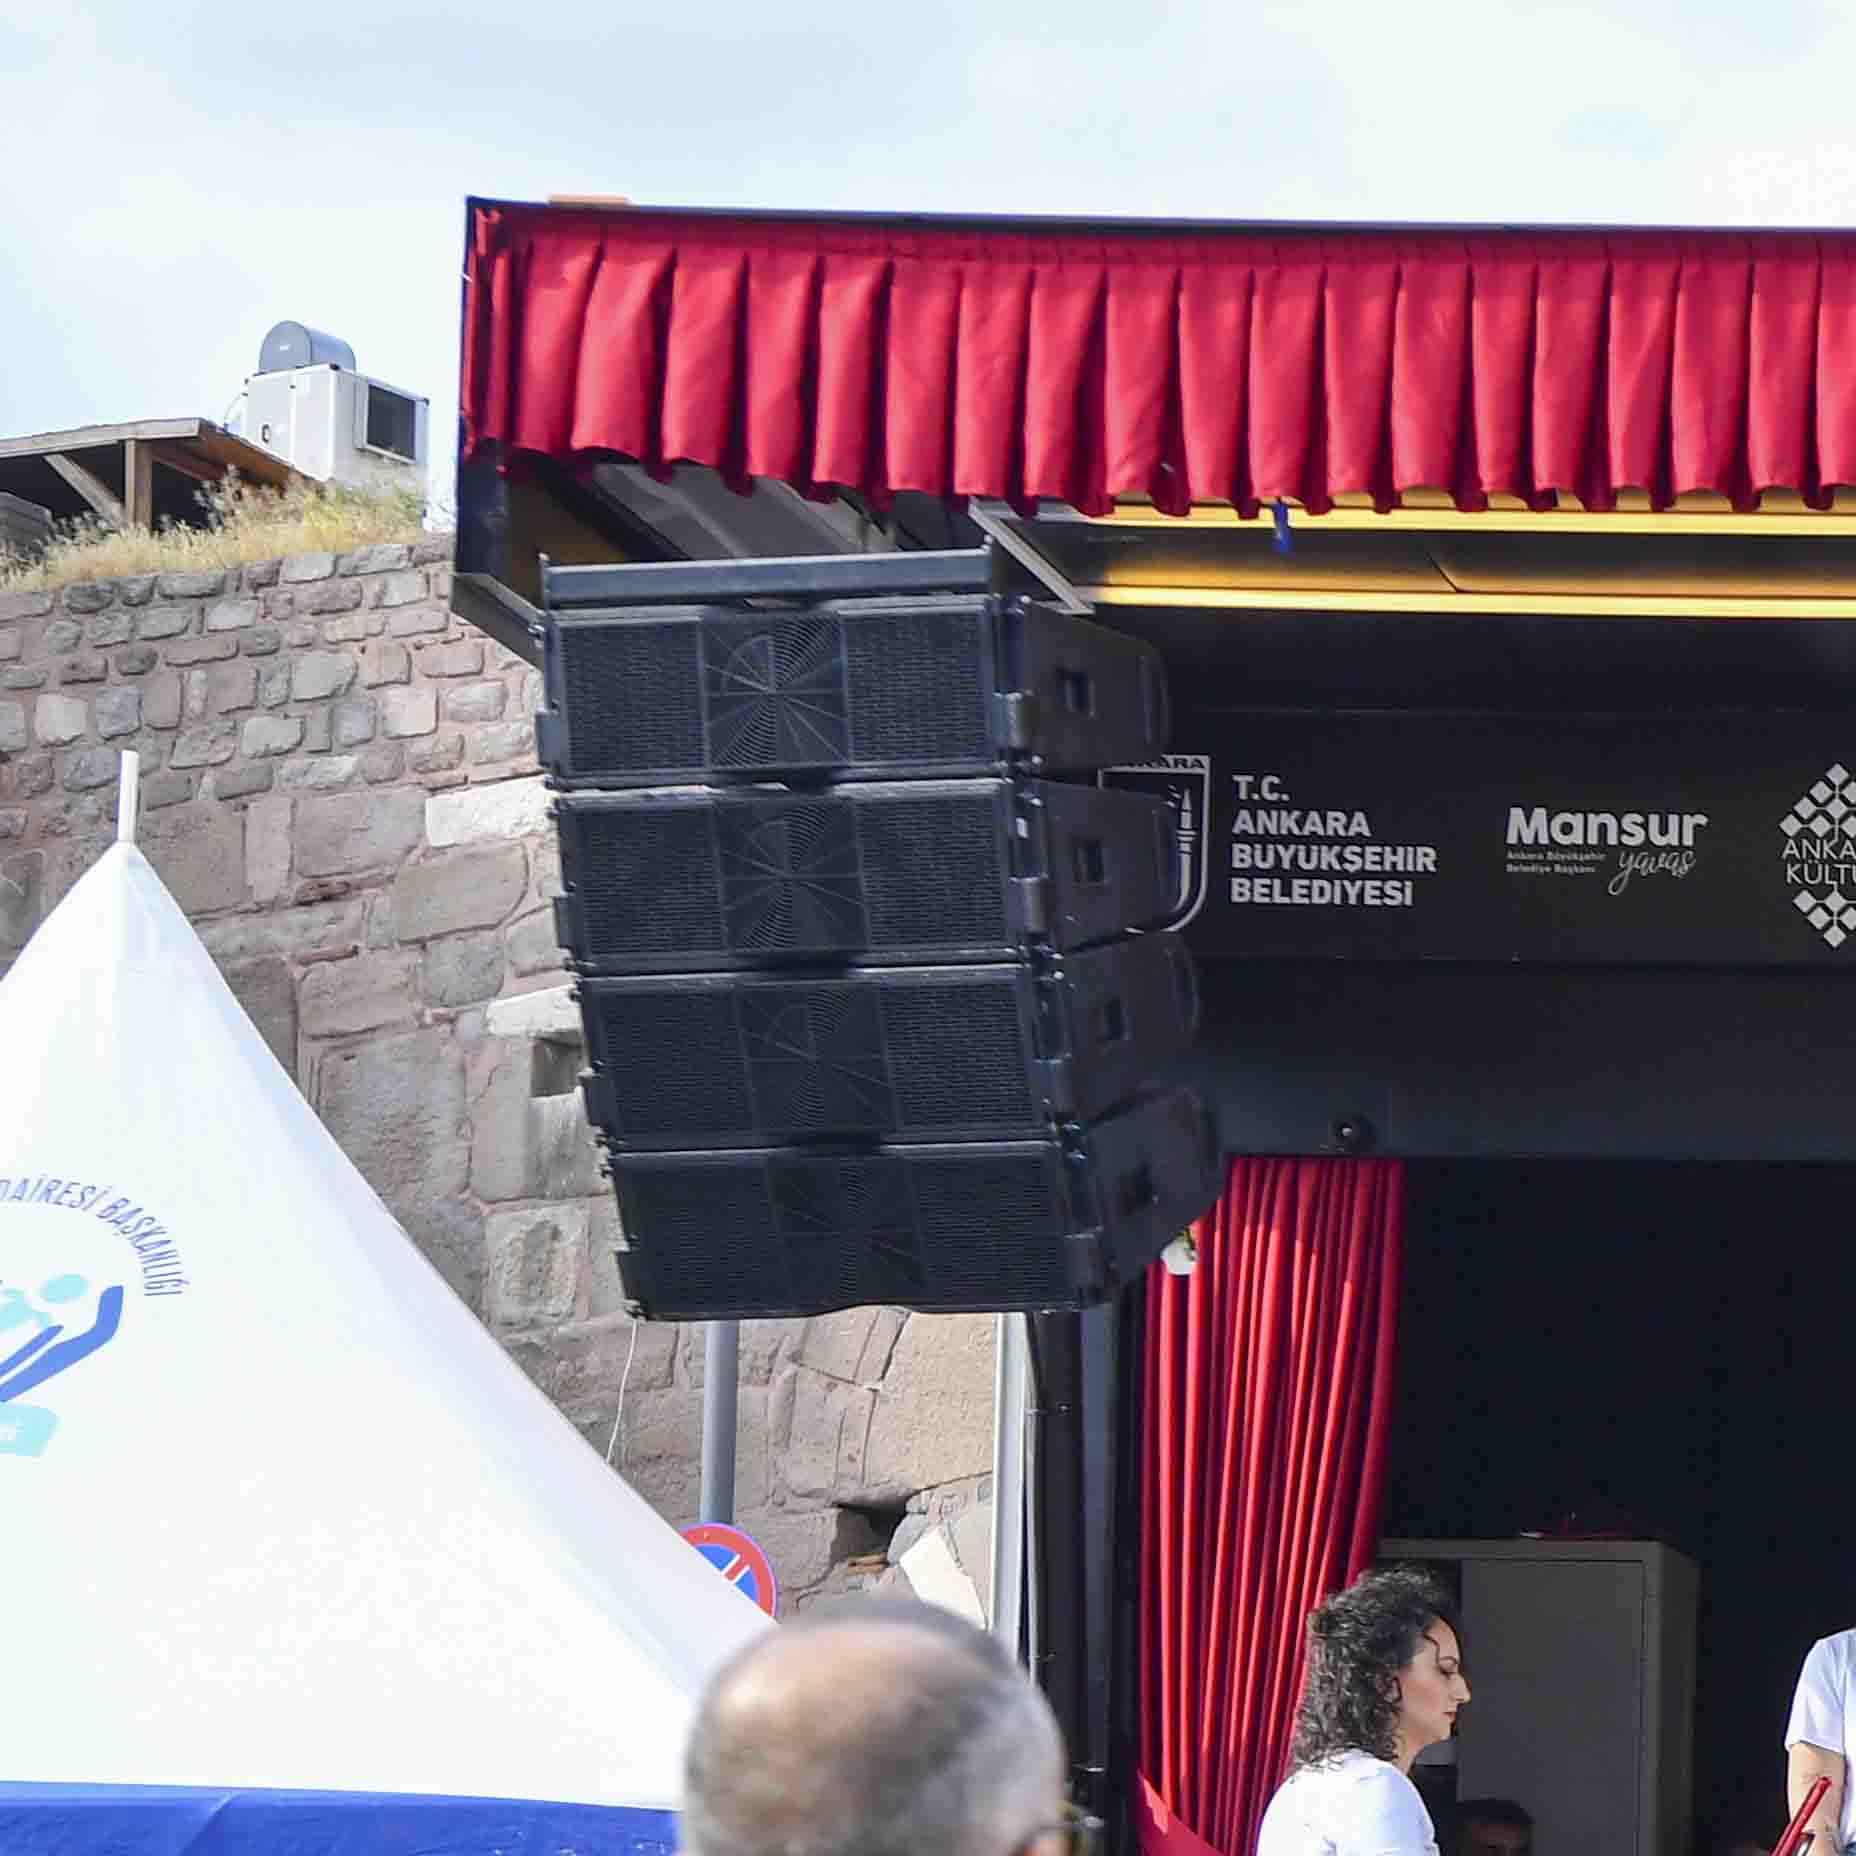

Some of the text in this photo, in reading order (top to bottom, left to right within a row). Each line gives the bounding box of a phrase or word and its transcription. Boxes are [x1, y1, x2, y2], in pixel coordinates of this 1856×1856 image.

[1232, 775, 1290, 801] T.C.
[1231, 809, 1372, 837] ANKARA
[1506, 807, 1709, 847] Mansur
